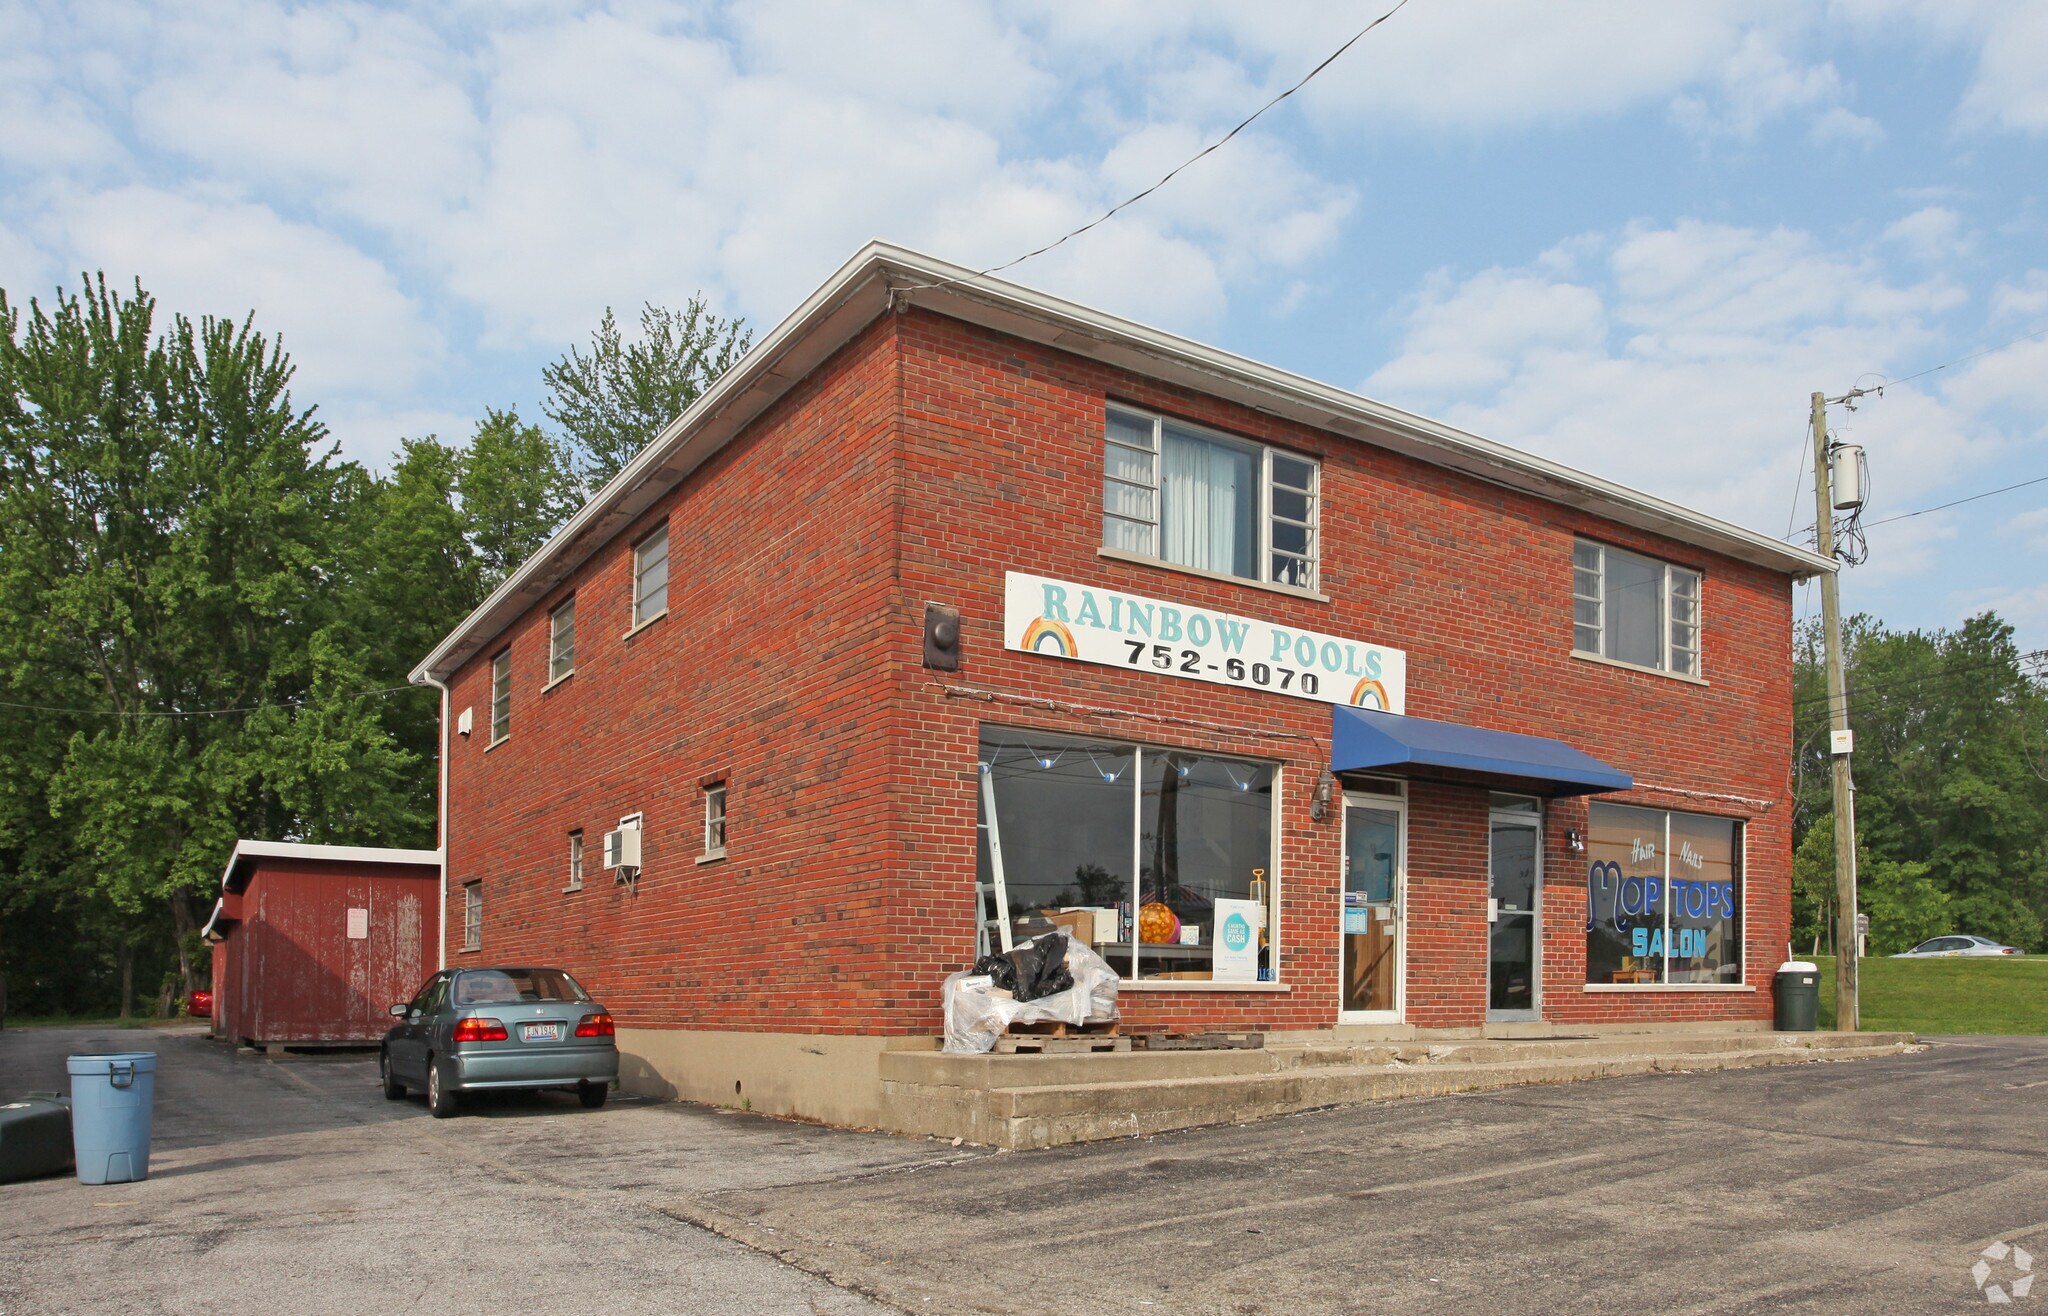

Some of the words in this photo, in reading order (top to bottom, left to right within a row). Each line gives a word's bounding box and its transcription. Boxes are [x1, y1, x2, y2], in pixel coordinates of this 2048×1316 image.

[1041, 583, 1250, 655] RAINBOW
[1270, 629, 1383, 681] POOLS
[1124, 640, 1320, 696] 752-6070
[1631, 837, 1656, 864] HAIR
[1679, 841, 1704, 870] NAILS
[1586, 859, 1661, 933] MOP
[1670, 879, 1735, 919] TOPS
[1227, 934, 1246, 943] CASH
[1632, 927, 1707, 959] SALON
